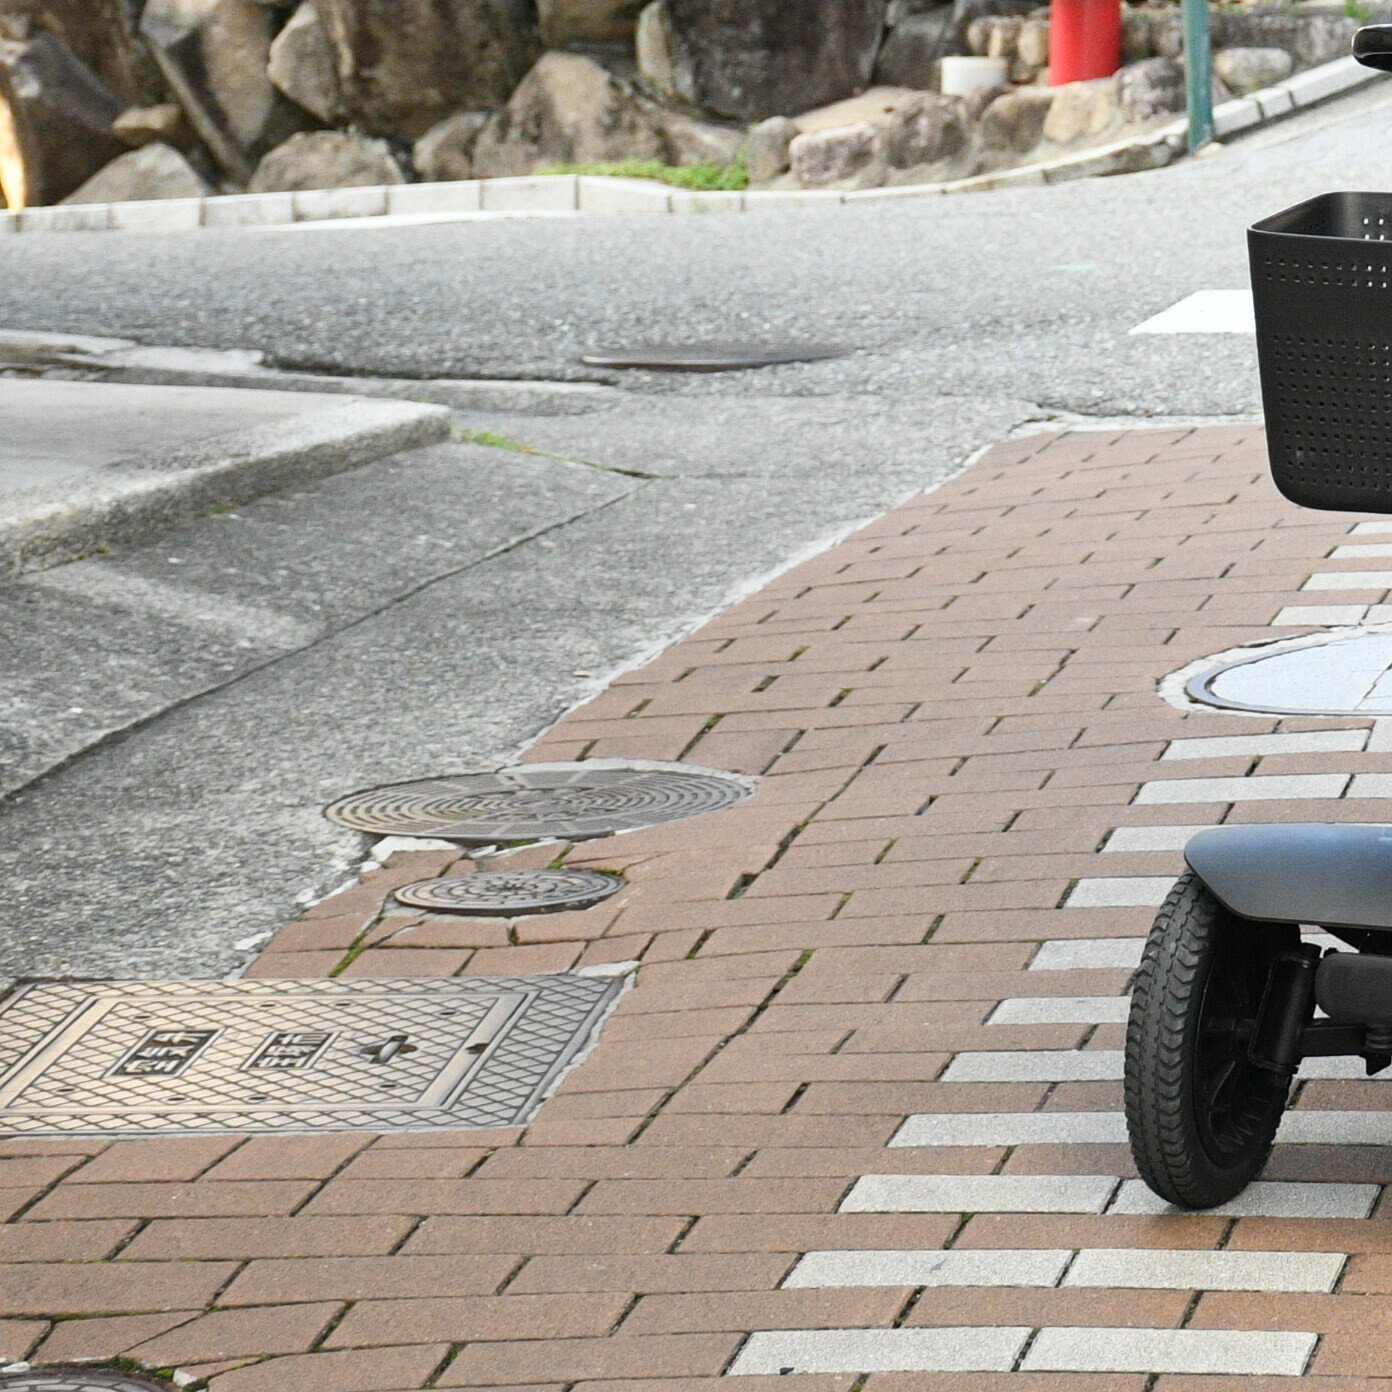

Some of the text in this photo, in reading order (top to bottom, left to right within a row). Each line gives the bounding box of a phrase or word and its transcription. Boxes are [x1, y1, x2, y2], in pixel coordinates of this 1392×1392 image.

[124, 1031, 209, 1074] 空気弁
[257, 1033, 328, 1068] 宝塚市
